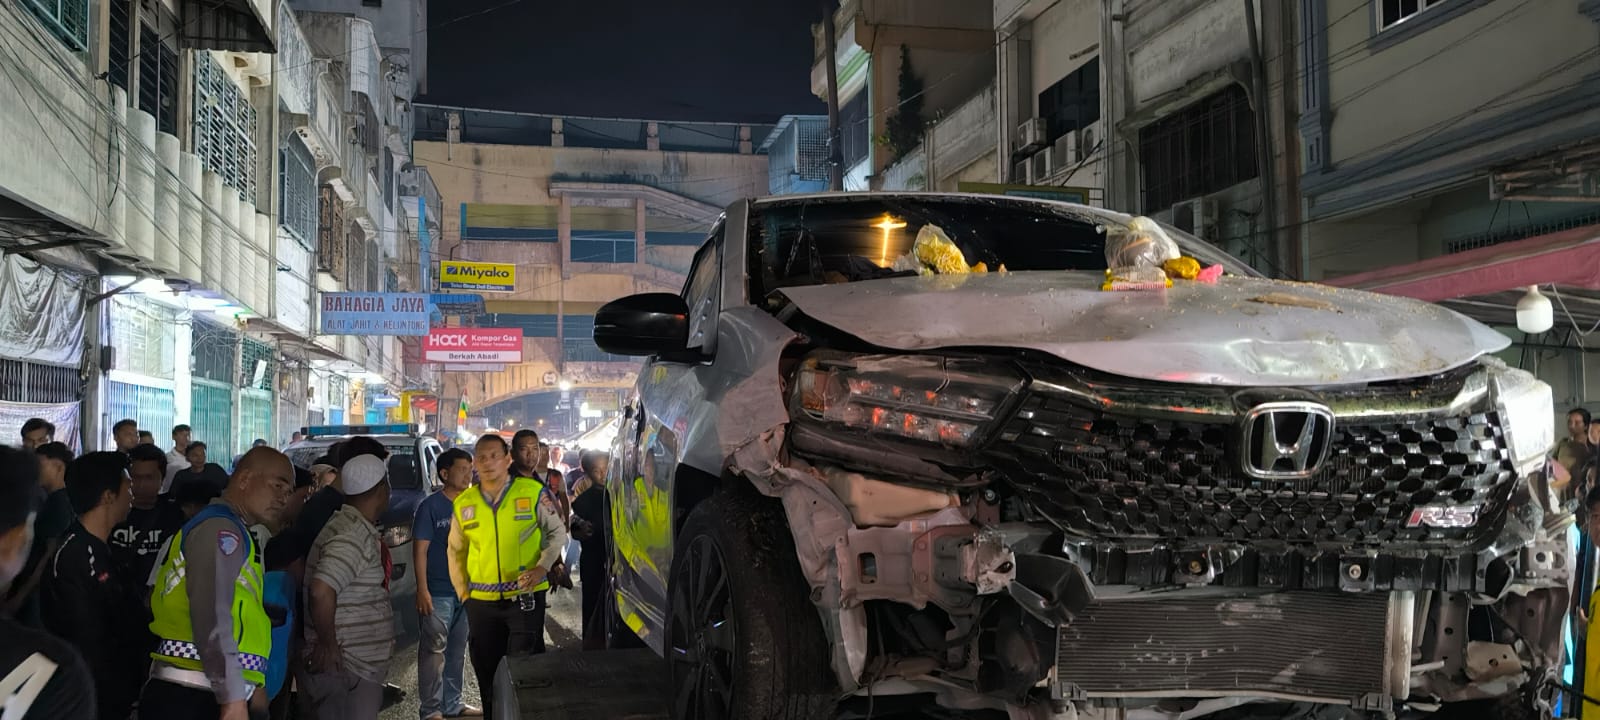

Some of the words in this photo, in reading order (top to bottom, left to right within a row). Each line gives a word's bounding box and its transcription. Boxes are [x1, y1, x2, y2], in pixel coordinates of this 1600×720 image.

[460, 266, 509, 279] Miyako
[325, 296, 386, 312] BAHAGIA
[392, 297, 425, 313] JAYA
[327, 319, 345, 329] ALAT
[351, 319, 371, 329] JAHIT
[429, 334, 468, 346] HOCK
[471, 334, 501, 343] Kompor
[503, 334, 517, 342] Gas
[1404, 504, 1480, 528] RS
